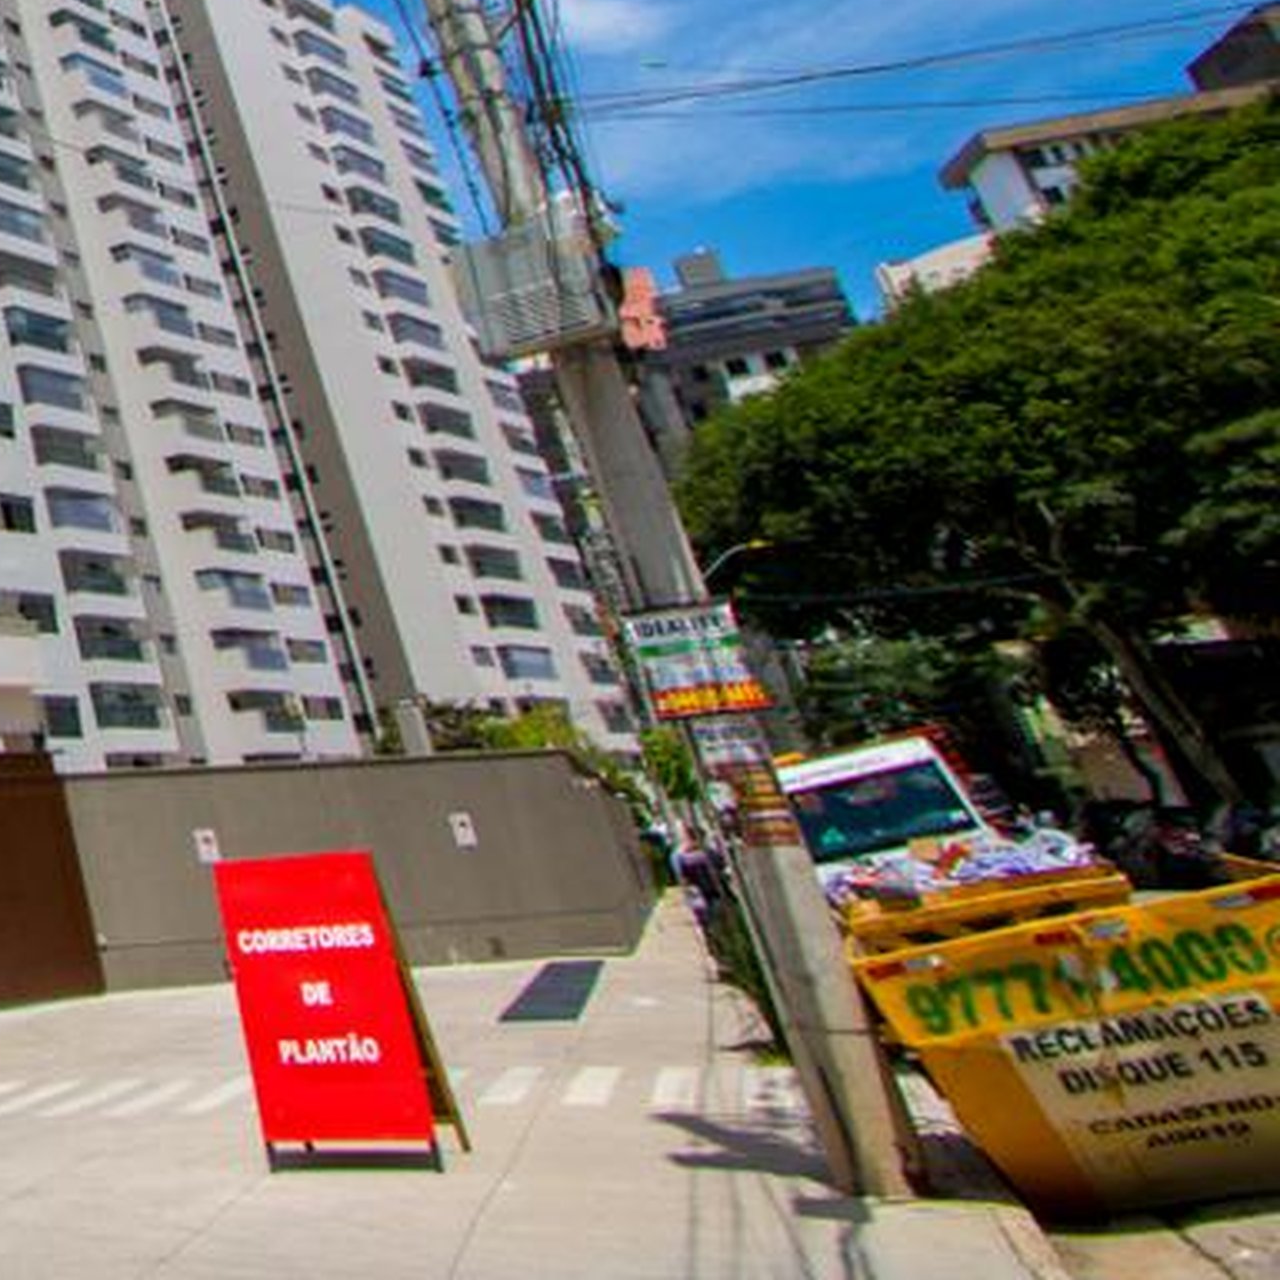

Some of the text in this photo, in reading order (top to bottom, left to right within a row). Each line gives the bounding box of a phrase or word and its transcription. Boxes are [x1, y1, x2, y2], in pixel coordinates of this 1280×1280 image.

[237, 923, 375, 953] CORRETORES
[300, 981, 332, 1005] DE
[278, 1033, 380, 1064] PLANTÃO
[1199, 1042, 1268, 1071] 115
